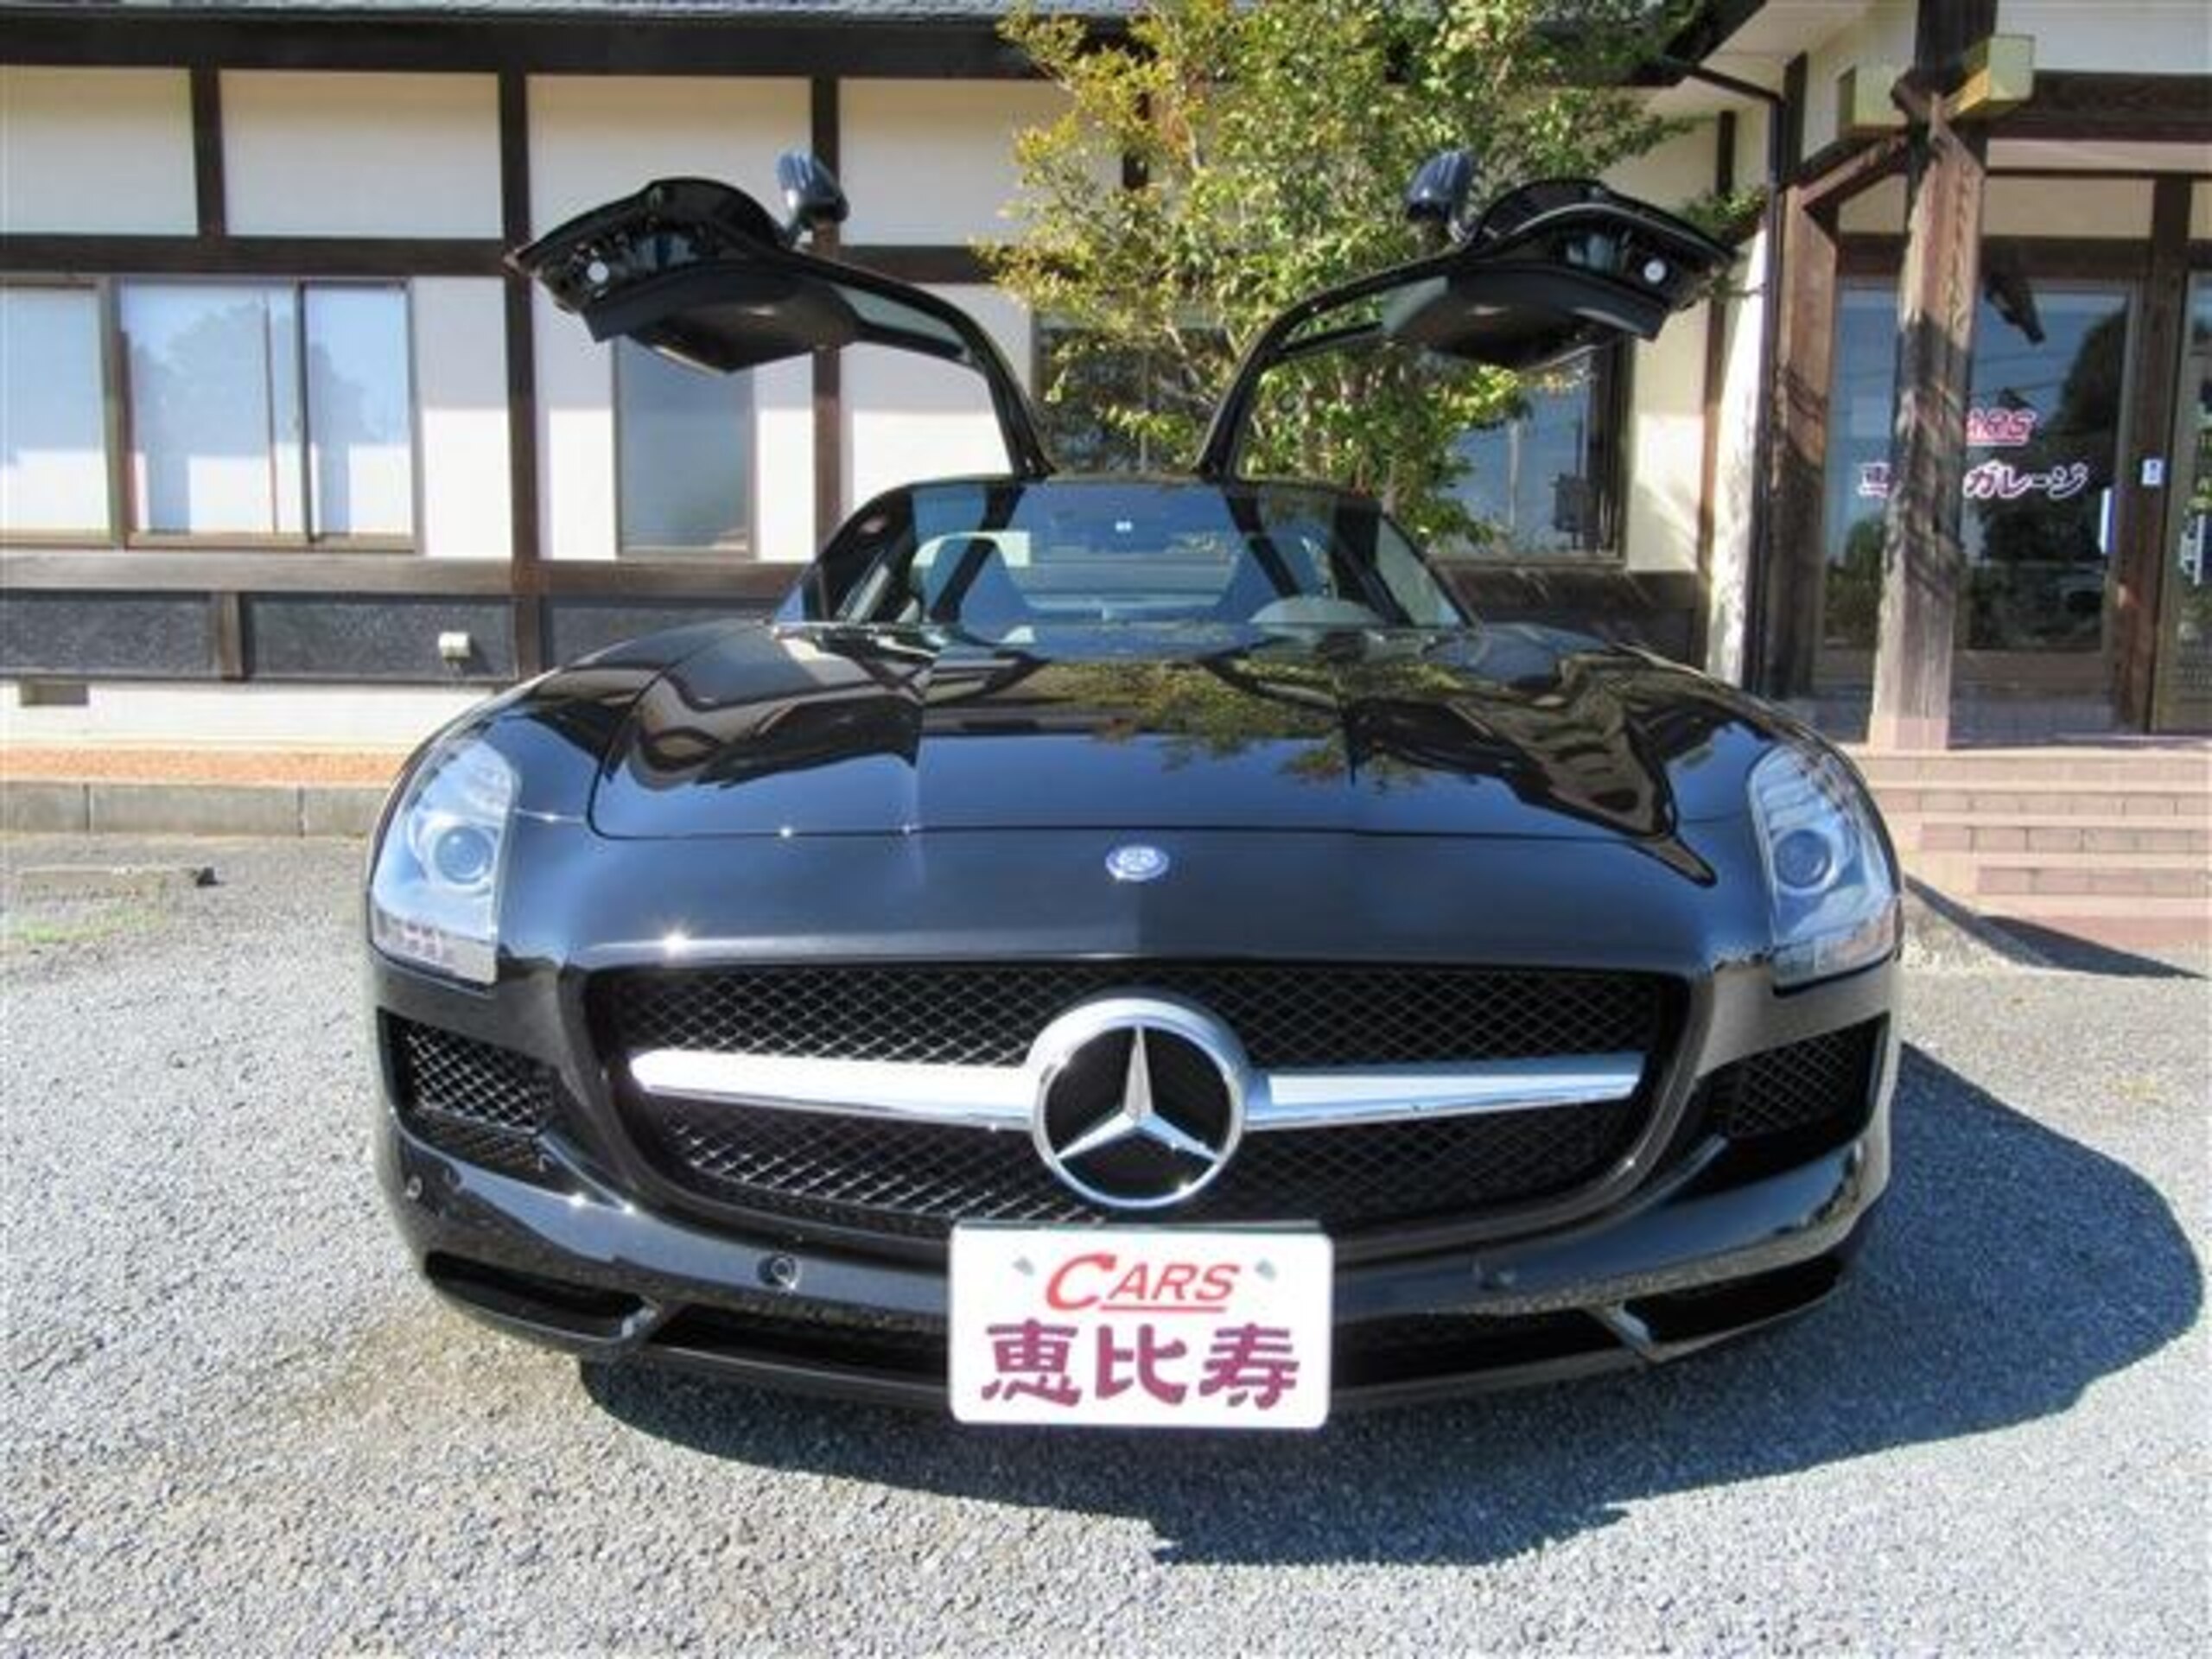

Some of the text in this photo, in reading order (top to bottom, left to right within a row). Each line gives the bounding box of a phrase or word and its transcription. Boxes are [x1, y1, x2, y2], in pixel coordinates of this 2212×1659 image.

[1966, 408, 2036, 440] ARS
[1045, 1251, 1241, 1312] CARS
[981, 1319, 1300, 1410] 恵比寿
